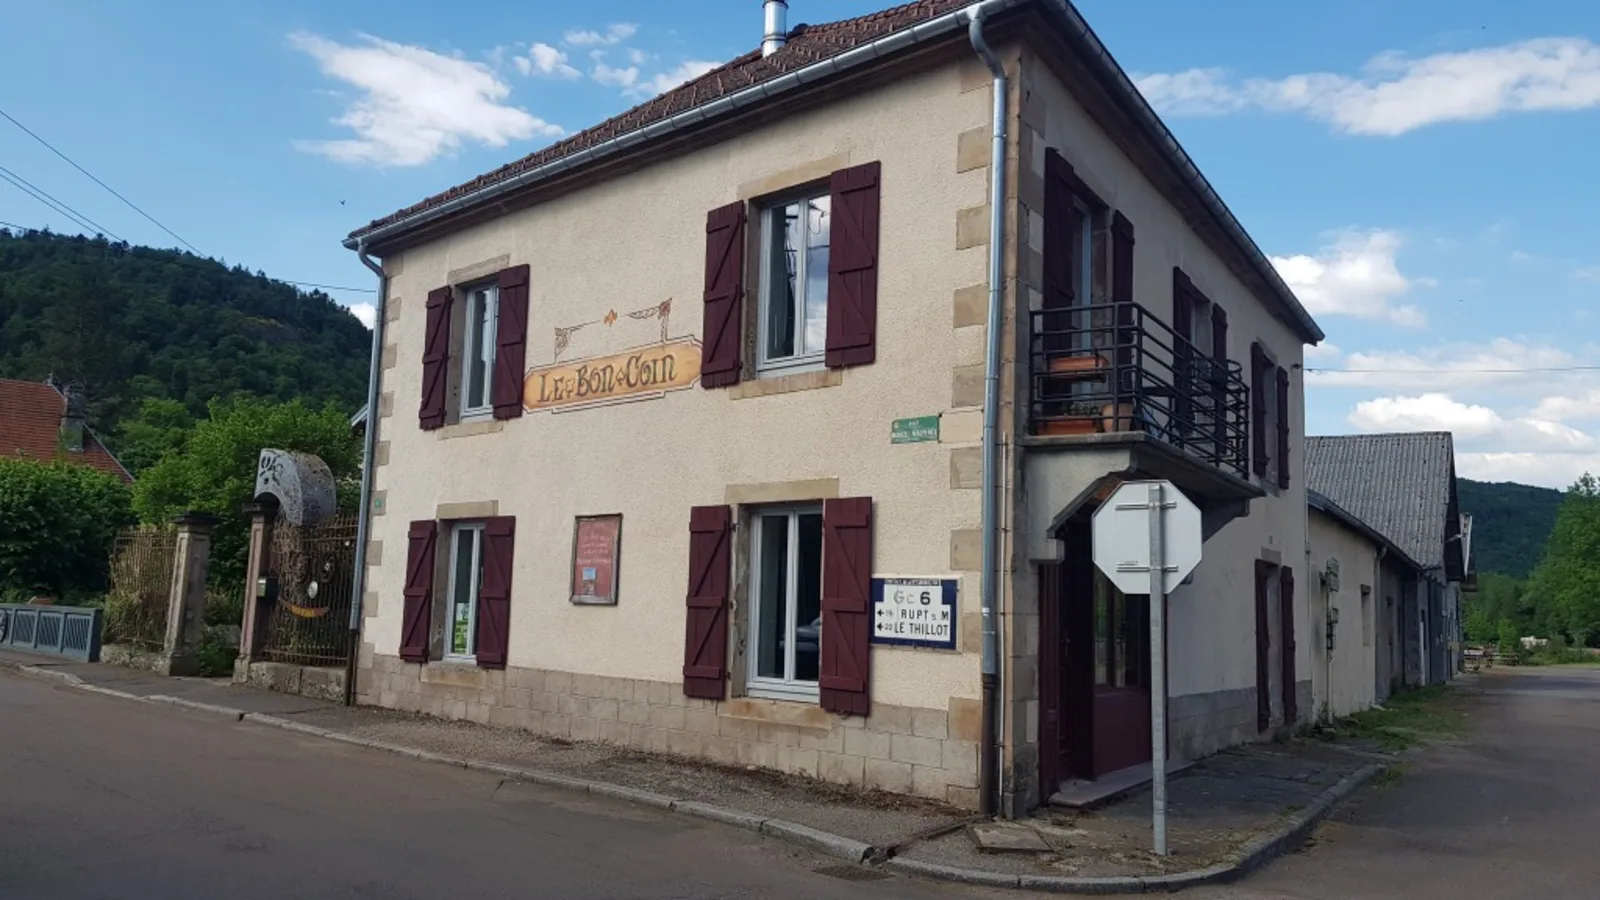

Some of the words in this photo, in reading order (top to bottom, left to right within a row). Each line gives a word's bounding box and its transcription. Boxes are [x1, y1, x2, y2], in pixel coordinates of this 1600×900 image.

[538, 374, 565, 402] LE
[575, 364, 615, 397] BON
[626, 353, 676, 388] COIN
[920, 591, 931, 605] 6
[901, 609, 929, 620] RUPT
[941, 610, 949, 620] M
[894, 622, 905, 634] LE
[909, 623, 949, 636] THILLOT
